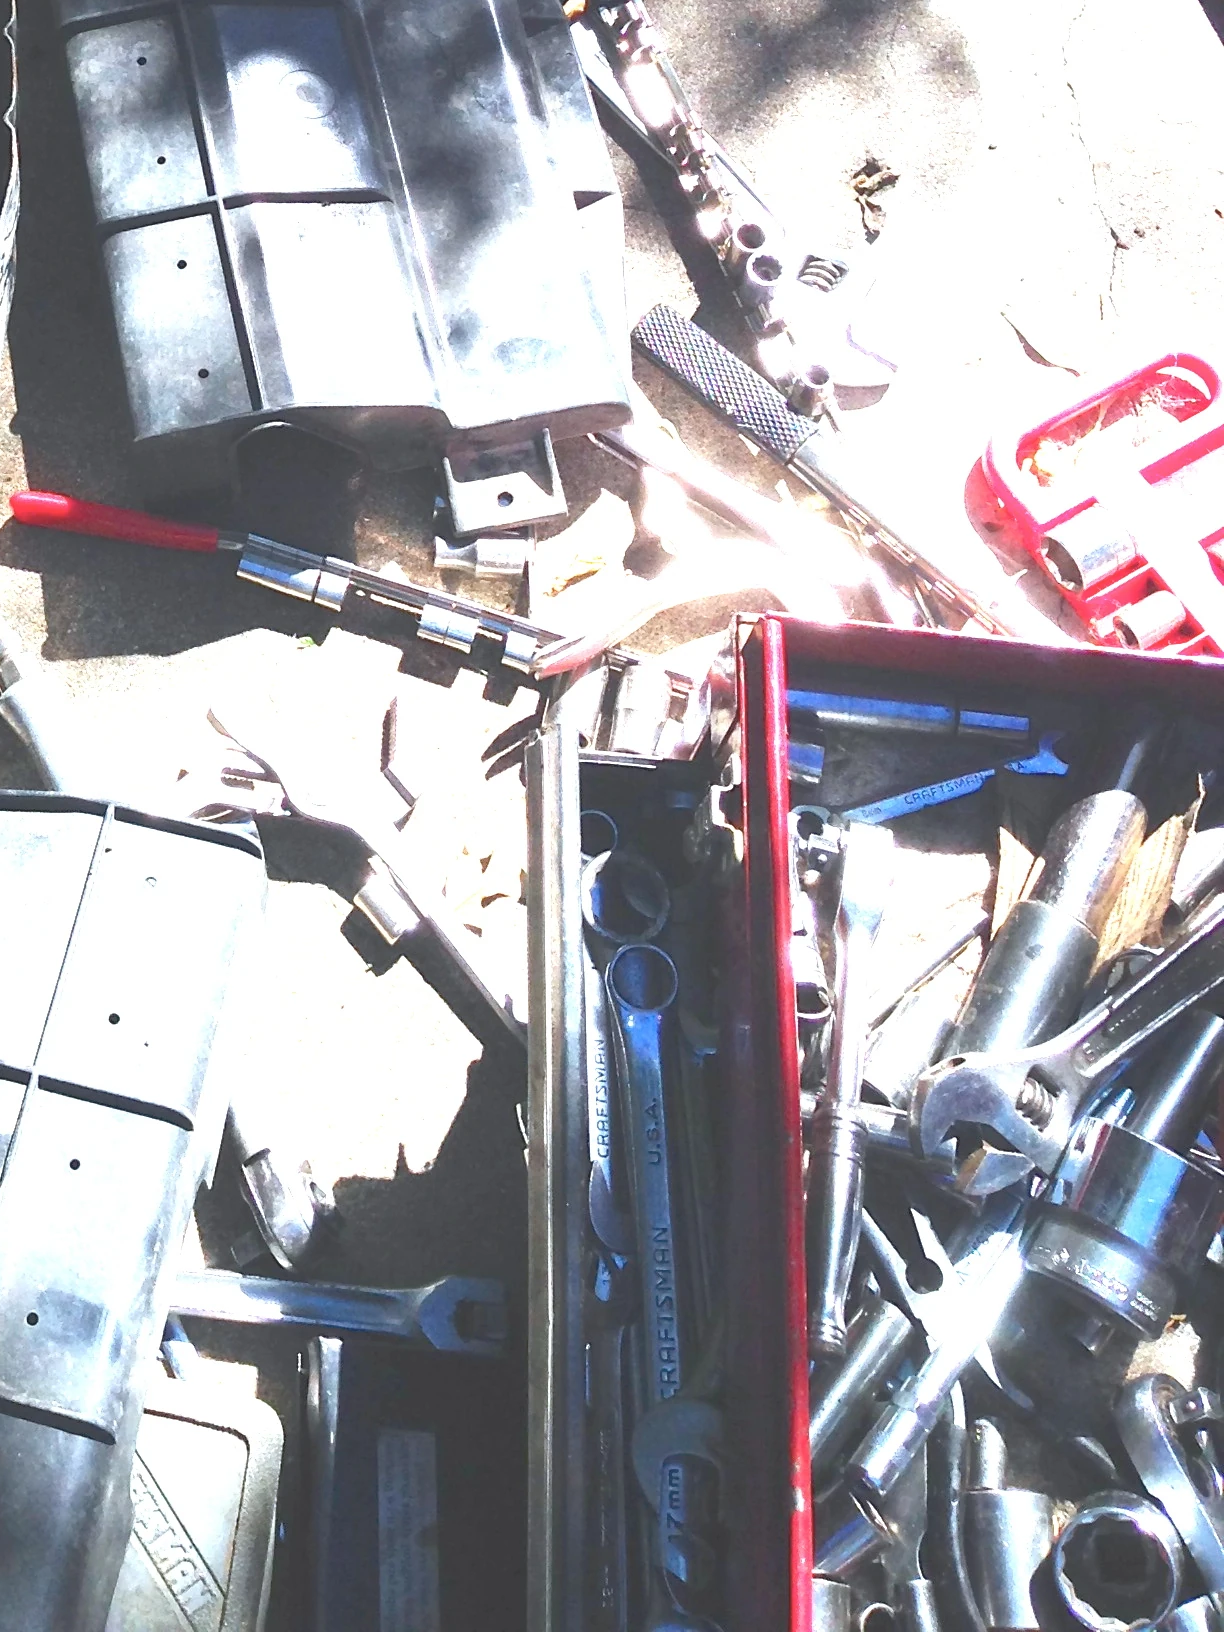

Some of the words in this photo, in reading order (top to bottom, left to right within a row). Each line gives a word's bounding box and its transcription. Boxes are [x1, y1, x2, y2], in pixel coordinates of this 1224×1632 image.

[903, 771, 987, 806] CRAFTSMAN
[596, 1038, 610, 1159] CRAFTSMAN
[644, 1097, 662, 1166] U.S.A.
